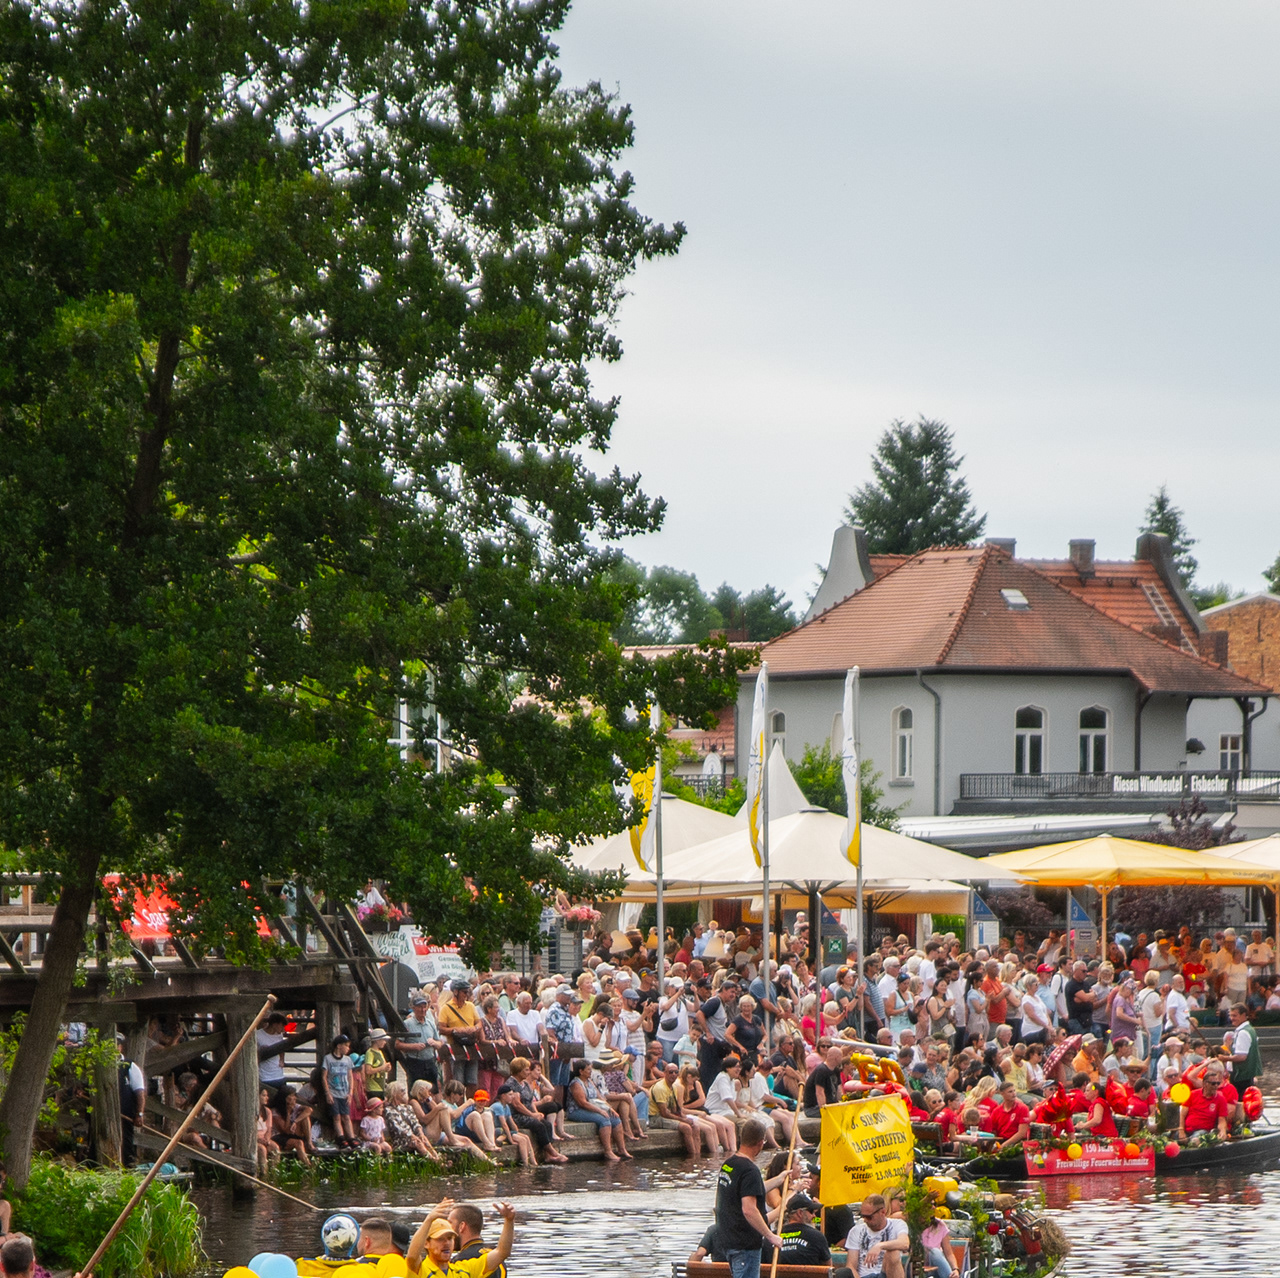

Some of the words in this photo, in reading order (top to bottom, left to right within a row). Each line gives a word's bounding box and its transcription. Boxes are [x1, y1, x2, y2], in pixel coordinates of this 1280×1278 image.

[1113, 775, 1139, 792] Riesen
[1140, 775, 1183, 792] Windbeutel
[1191, 775, 1229, 792] Eisbecher
[873, 1150, 901, 1164] Samstag
